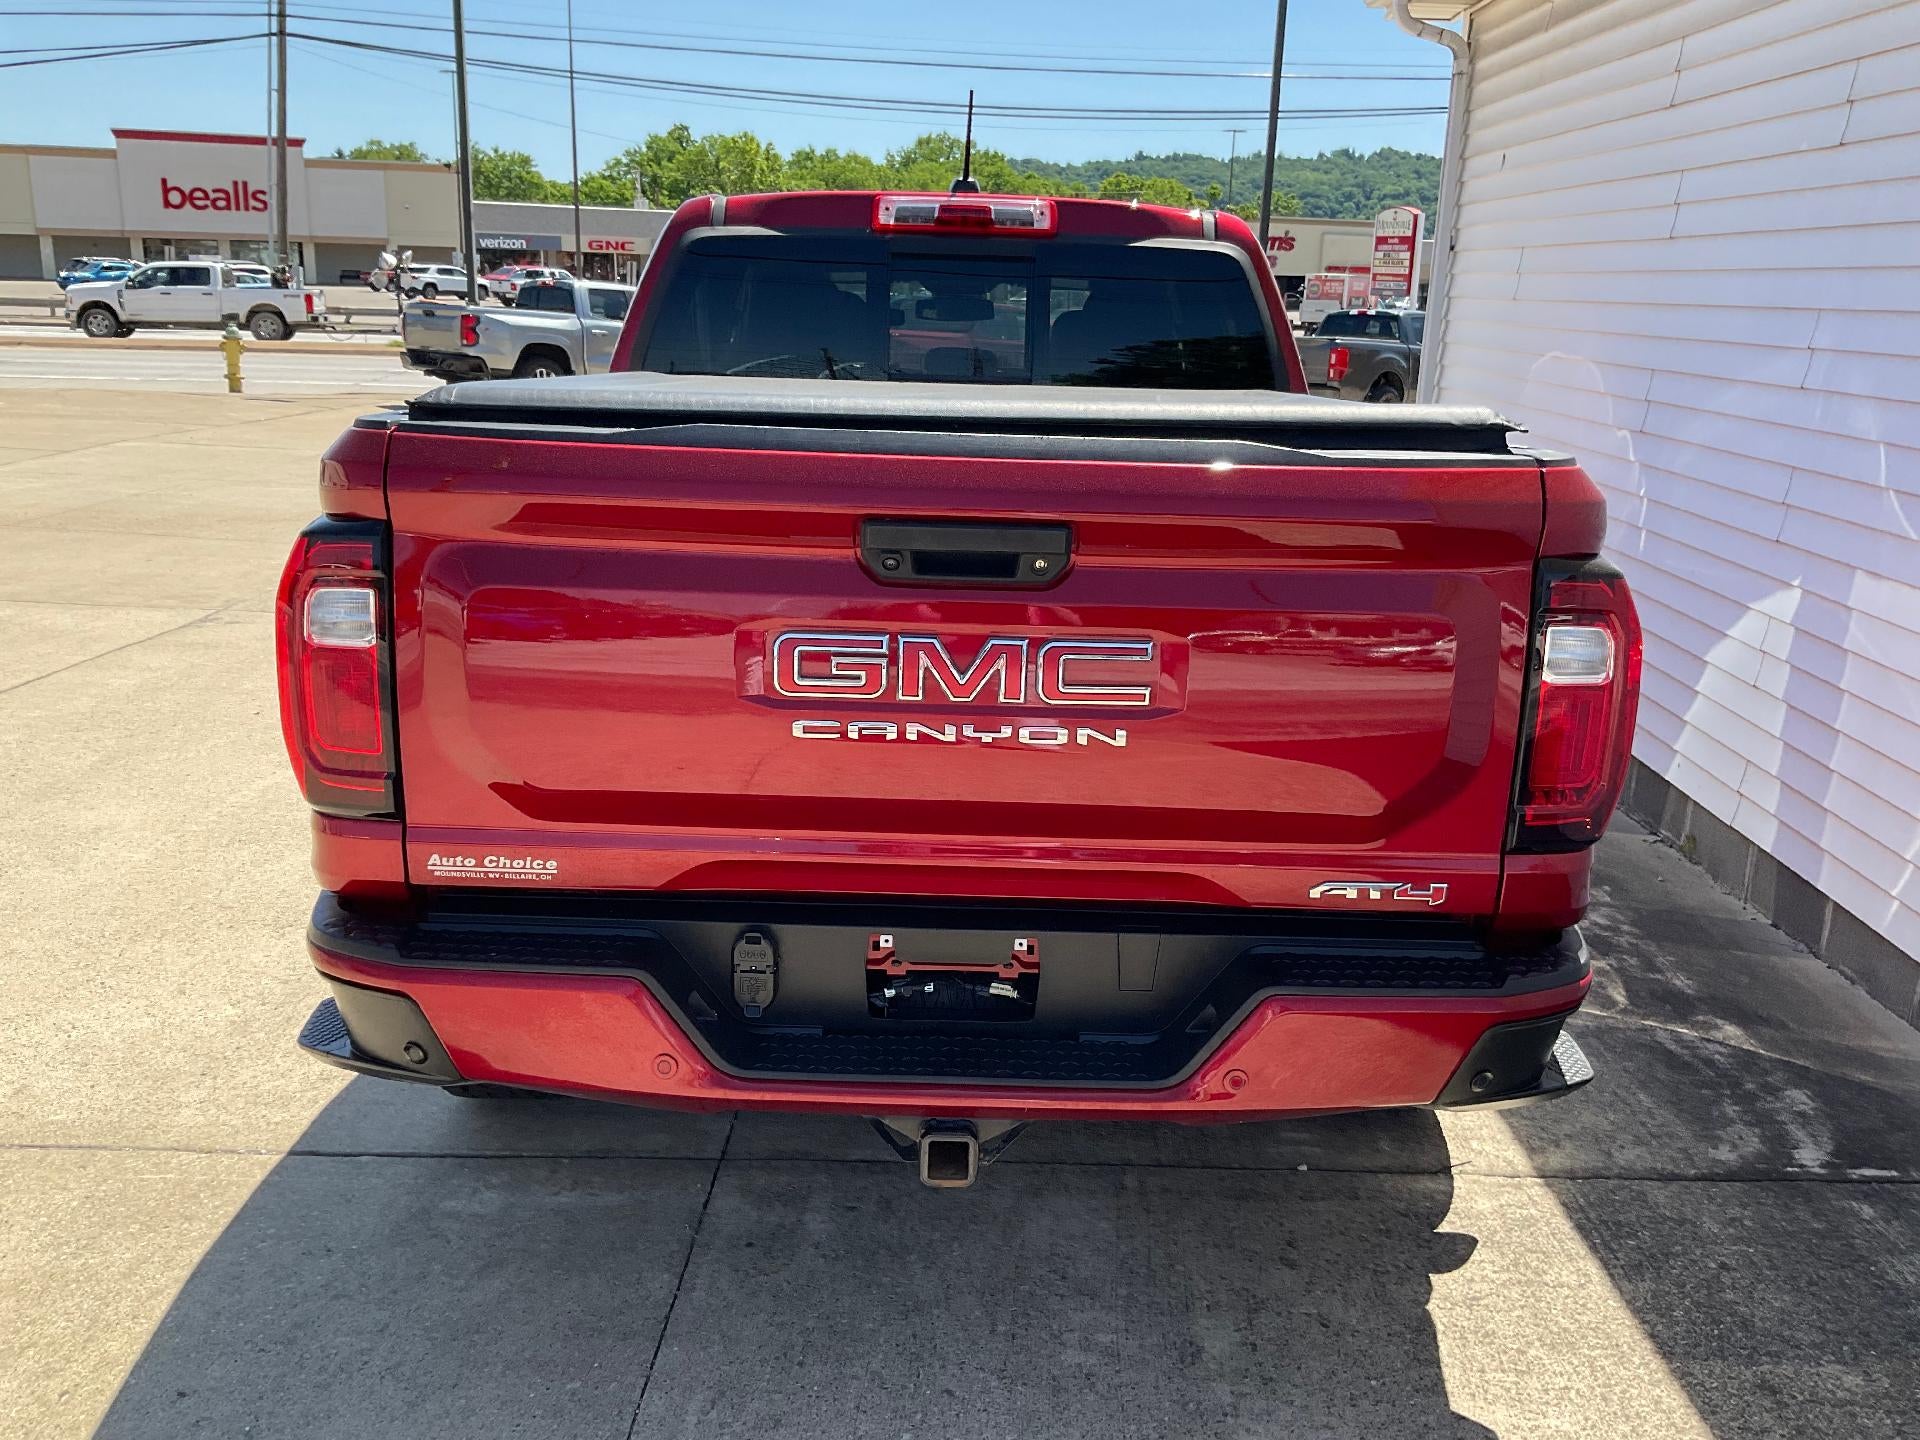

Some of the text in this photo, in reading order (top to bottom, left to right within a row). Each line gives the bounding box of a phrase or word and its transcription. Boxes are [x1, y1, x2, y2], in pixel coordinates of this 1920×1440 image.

[160, 177, 269, 212] bealls
[479, 236, 527, 249] verizon
[587, 240, 635, 251] GNC
[772, 631, 1154, 706] GMC
[791, 720, 1128, 747] CANYON
[427, 853, 558, 870] Auto Choice
[1308, 881, 1449, 906] AT4
